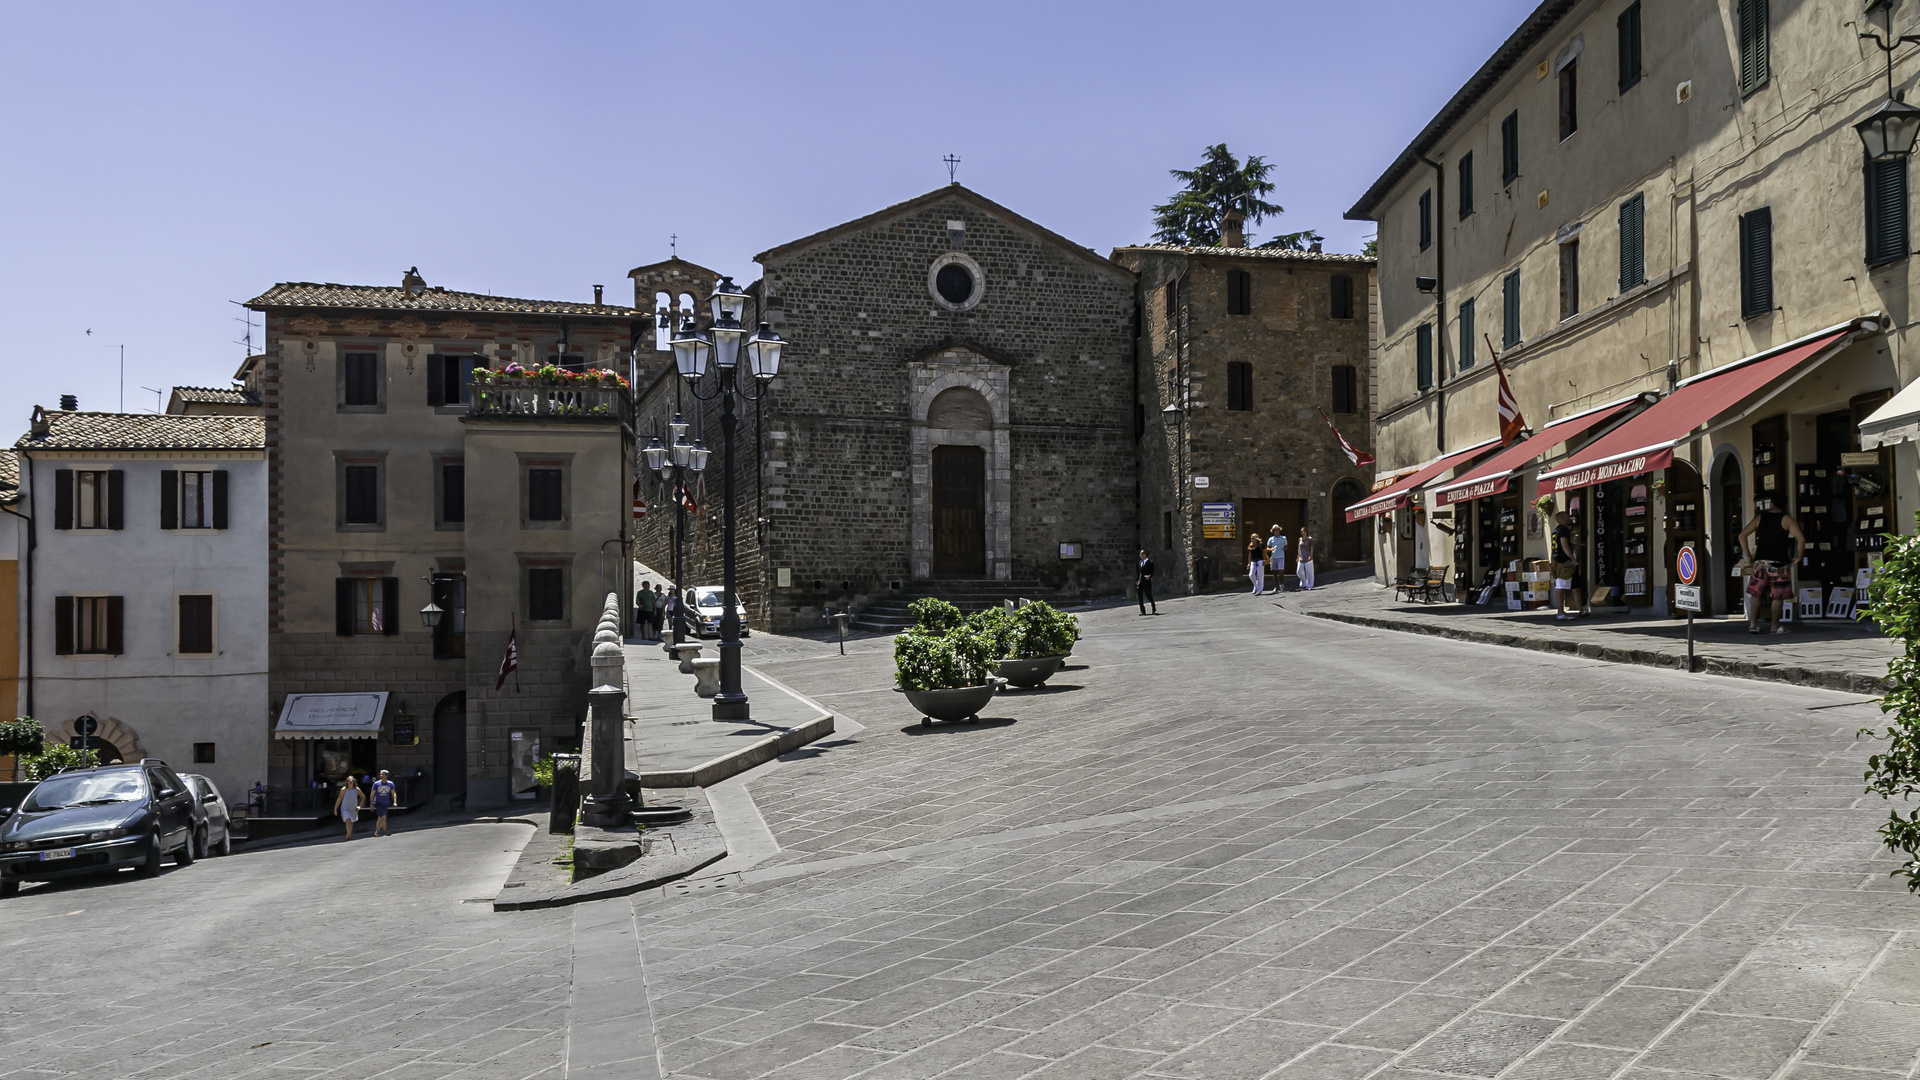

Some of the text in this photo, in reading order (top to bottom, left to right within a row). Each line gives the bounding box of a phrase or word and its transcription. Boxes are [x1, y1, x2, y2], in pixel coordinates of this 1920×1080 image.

[1554, 470, 1590, 490] BRUNELLO
[1597, 457, 1646, 480] MONTALCINO
[1447, 487, 1469, 502] ENOTECA
[1474, 481, 1495, 496] PIAZZA
[1597, 506, 1605, 534] VINO
[1597, 542, 1606, 585] GRAPPA
